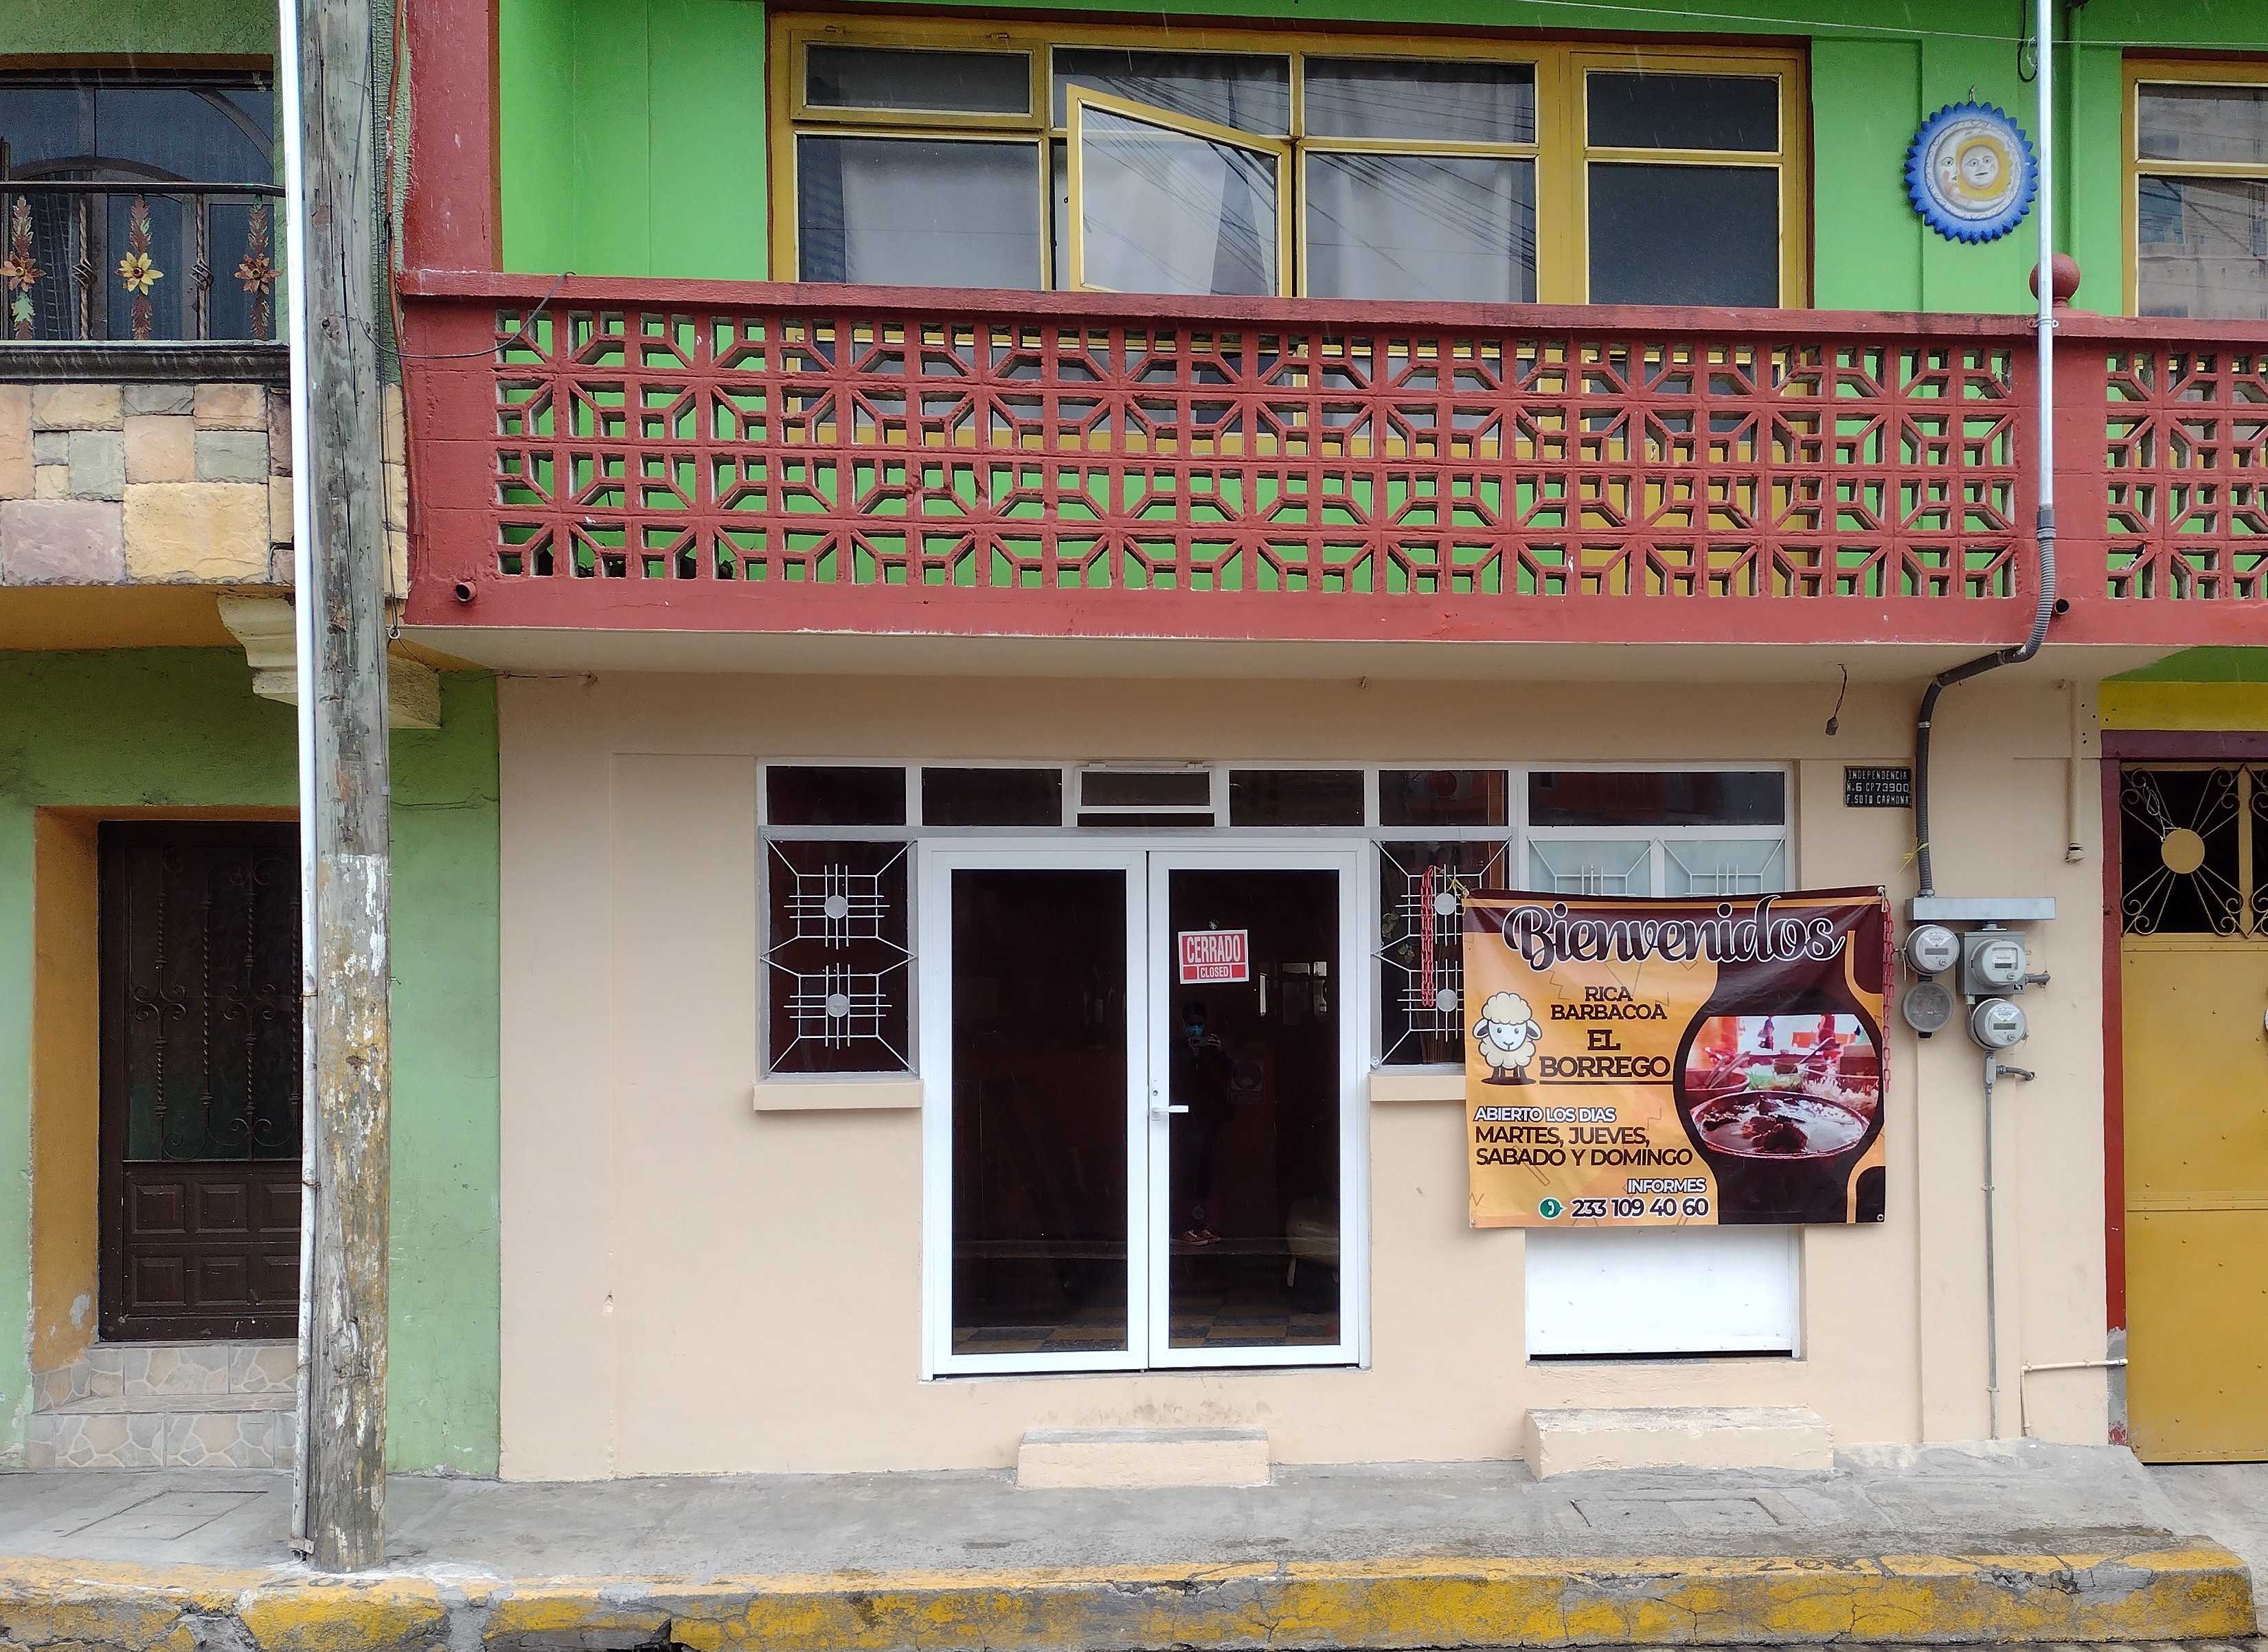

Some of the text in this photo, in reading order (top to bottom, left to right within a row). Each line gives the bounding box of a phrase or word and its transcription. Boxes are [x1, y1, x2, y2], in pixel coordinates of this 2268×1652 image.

[1848, 770, 1907, 780] INDEPENDENCIA
[1502, 895, 1846, 972] Bienvenidos
[1187, 935, 1241, 963] CERRADO
[1200, 966, 1229, 978] CLOSED
[1585, 986, 1633, 1002] RICA
[1550, 1004, 1668, 1020] BARBACOA
[1587, 1029, 1621, 1051] EL
[1539, 1056, 1671, 1078] BORREGO
[1473, 1107, 1616, 1122] ABIERTO LOS DIAS
[1475, 1126, 1650, 1148] MARTES, JUEVES,
[1476, 1147, 1693, 1166] SABADO Y DOMINGO
[1627, 1178, 1707, 1194] INFORMES
[1571, 1197, 1709, 1217] 233 109 40 60
